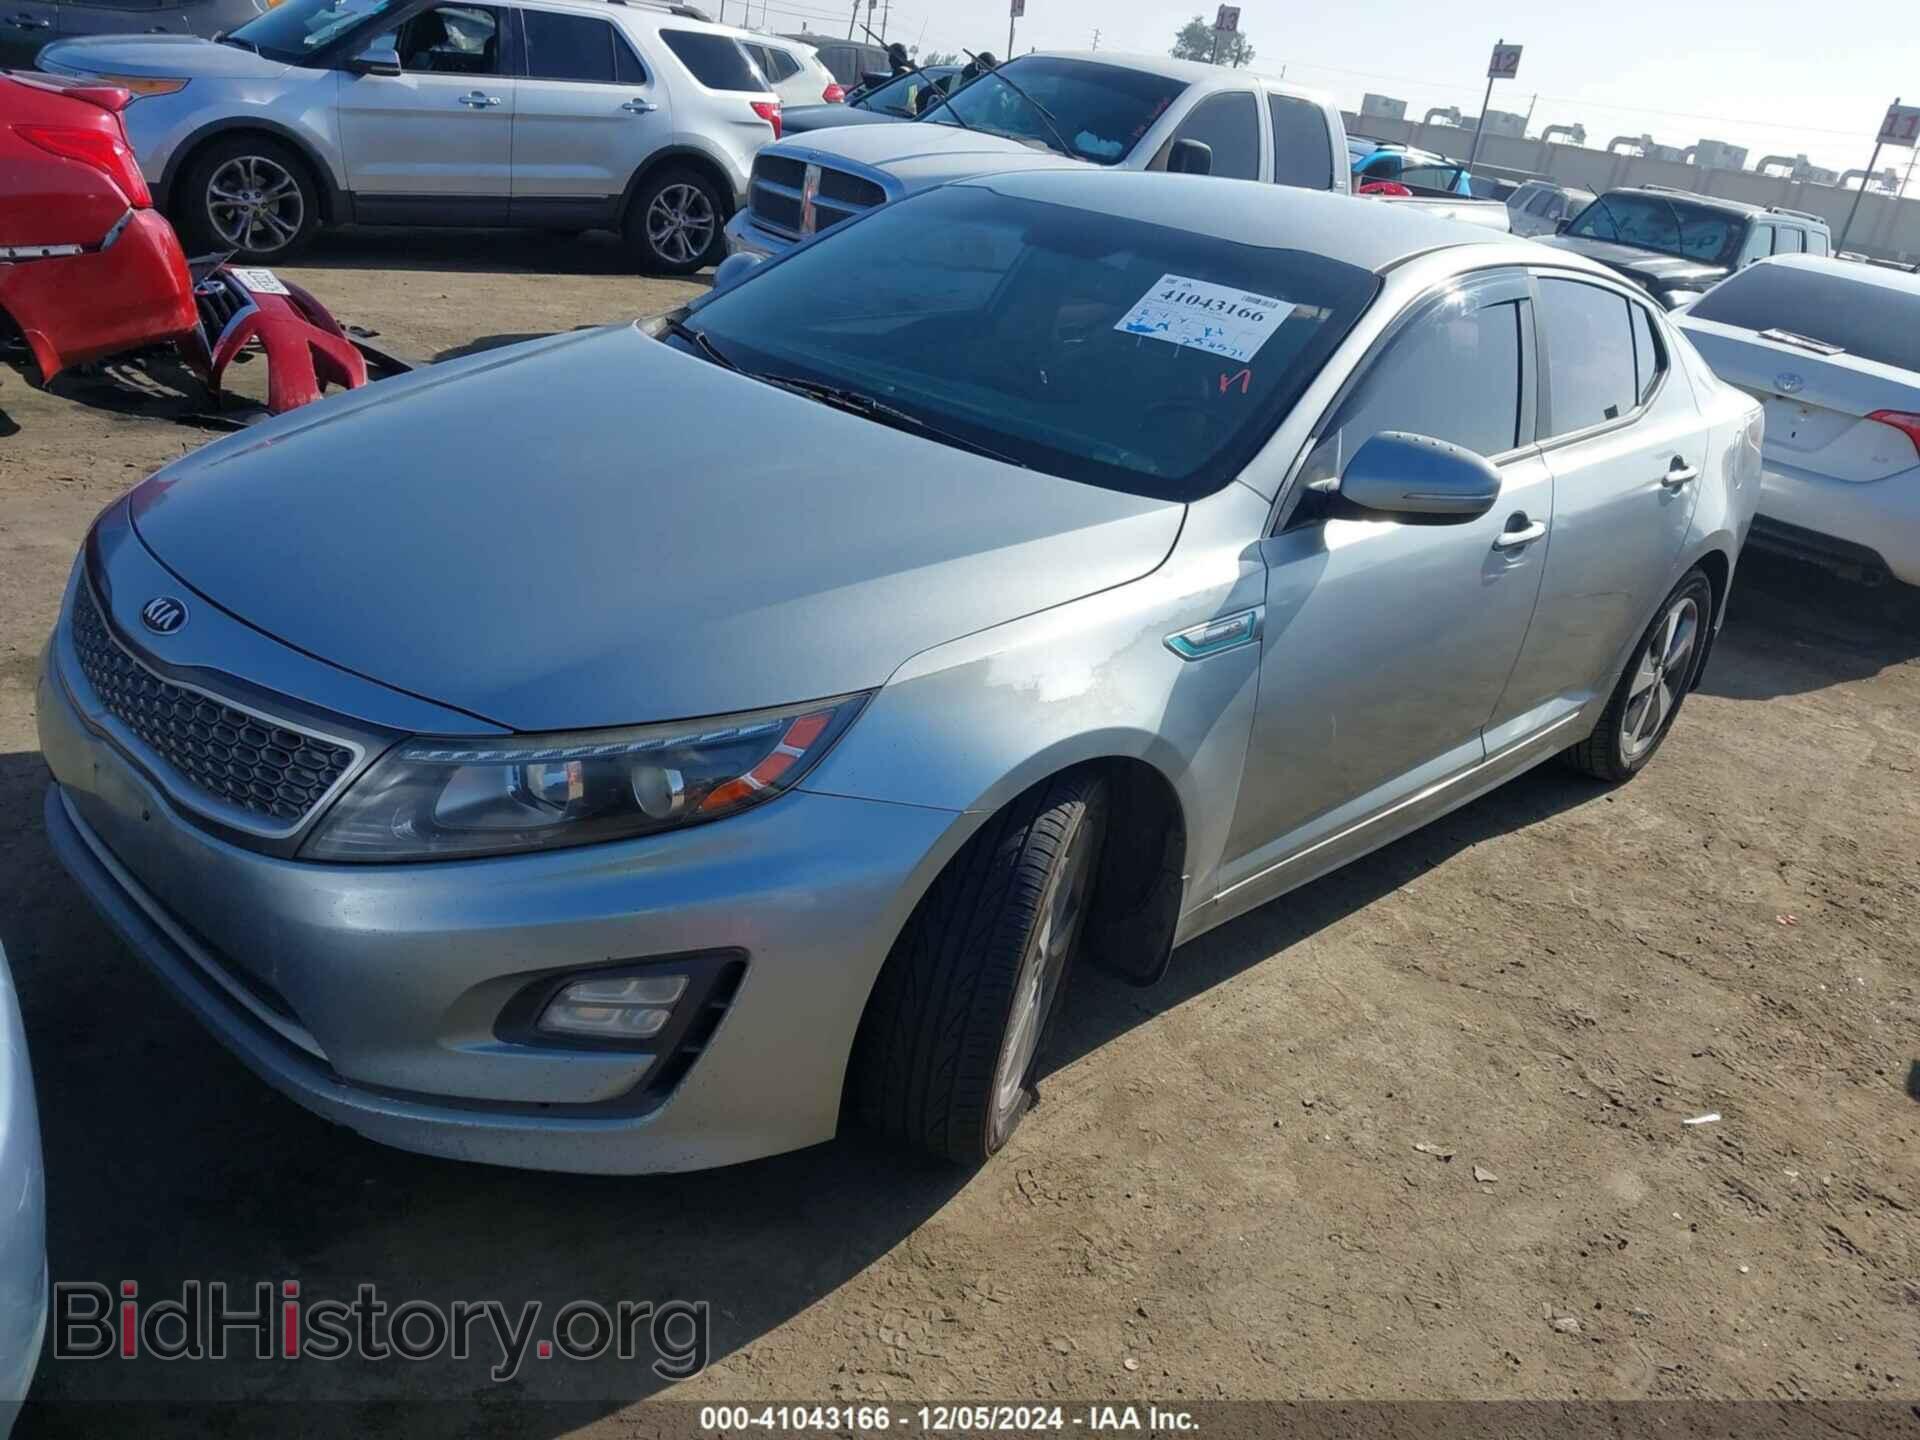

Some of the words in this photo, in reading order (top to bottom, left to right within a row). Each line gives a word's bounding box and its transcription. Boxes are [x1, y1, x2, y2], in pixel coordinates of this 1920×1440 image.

[1216, 10, 1239, 31] 13
[1490, 50, 1520, 73] 12
[1881, 112, 1919, 140] 11
[1159, 288, 1265, 323] 41043166
[143, 597, 180, 630] KIA
